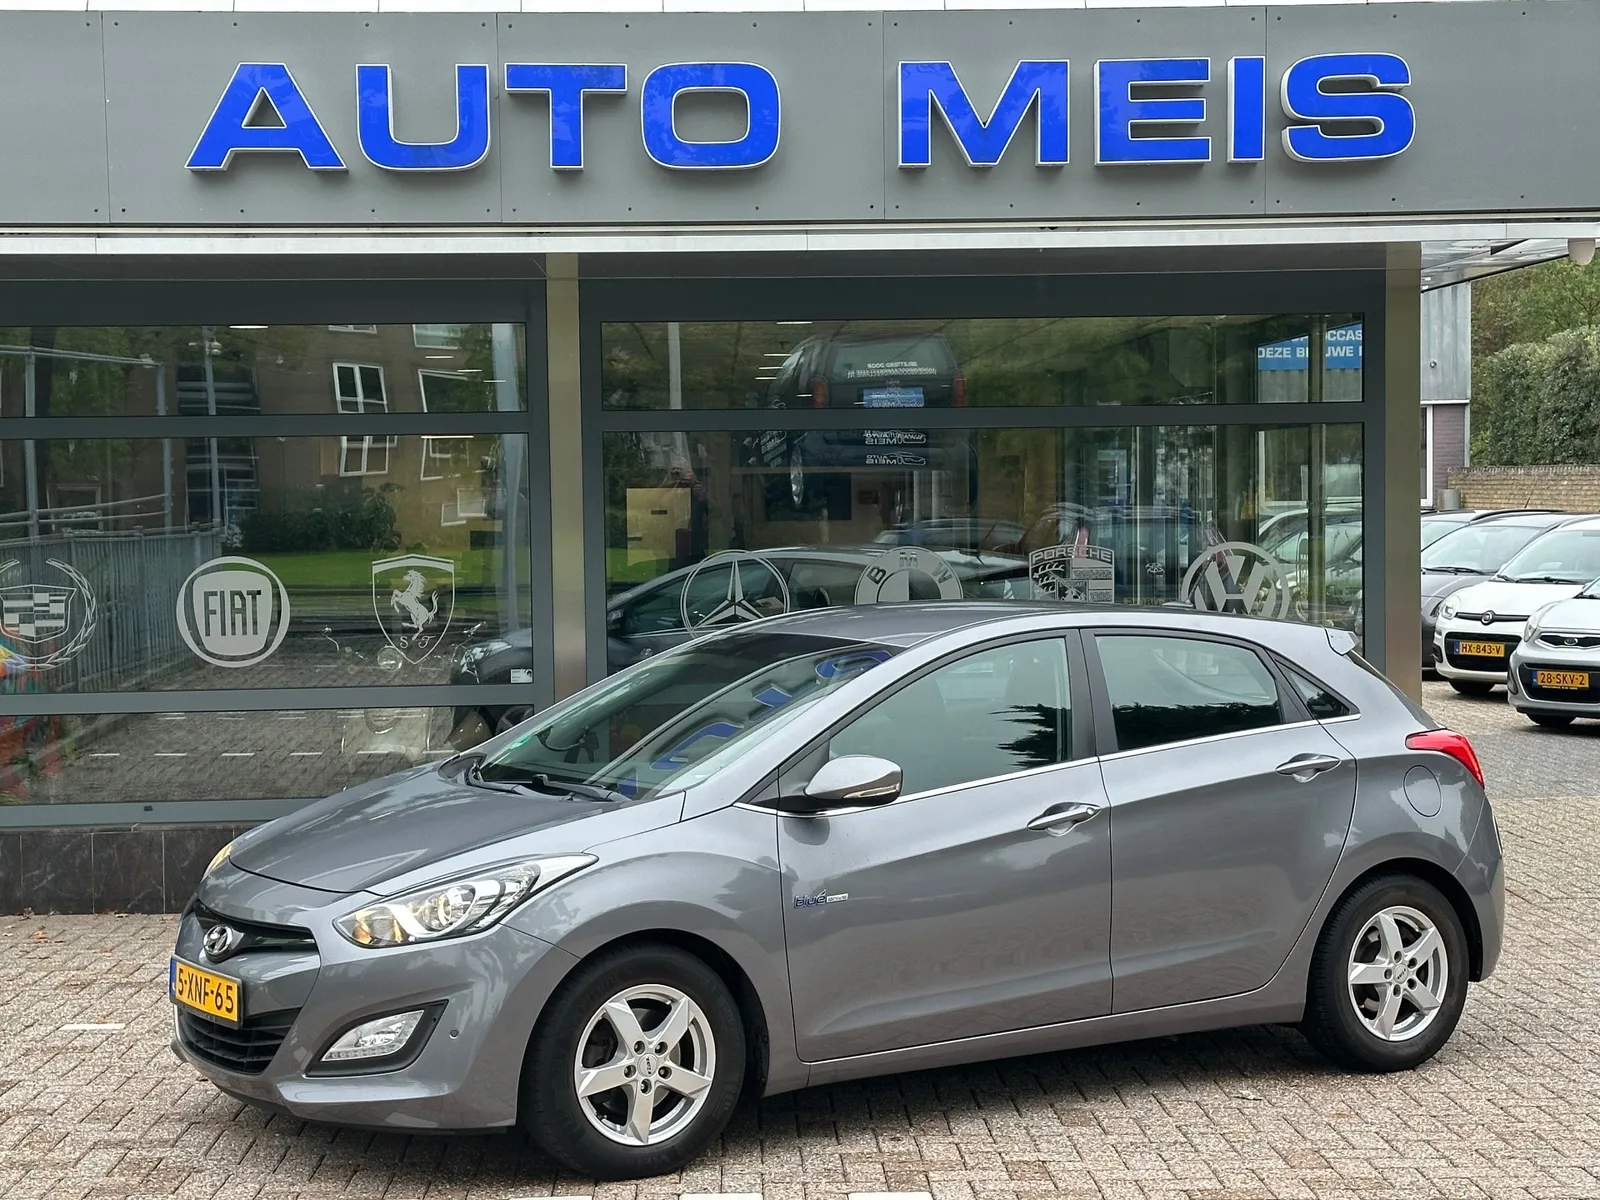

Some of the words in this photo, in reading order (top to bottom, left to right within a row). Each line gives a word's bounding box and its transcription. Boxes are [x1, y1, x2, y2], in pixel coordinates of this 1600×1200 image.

[184, 61, 782, 172] AUTO
[897, 52, 1416, 167] MEIS
[1257, 347, 1291, 358] DEZE
[1032, 547, 1112, 565] PORSCHE
[203, 590, 261, 637] FIAT
[1461, 642, 1501, 655] HX-843-V
[1540, 672, 1585, 686] 28-SKV-2
[177, 968, 234, 1014] 5-XNF-65
